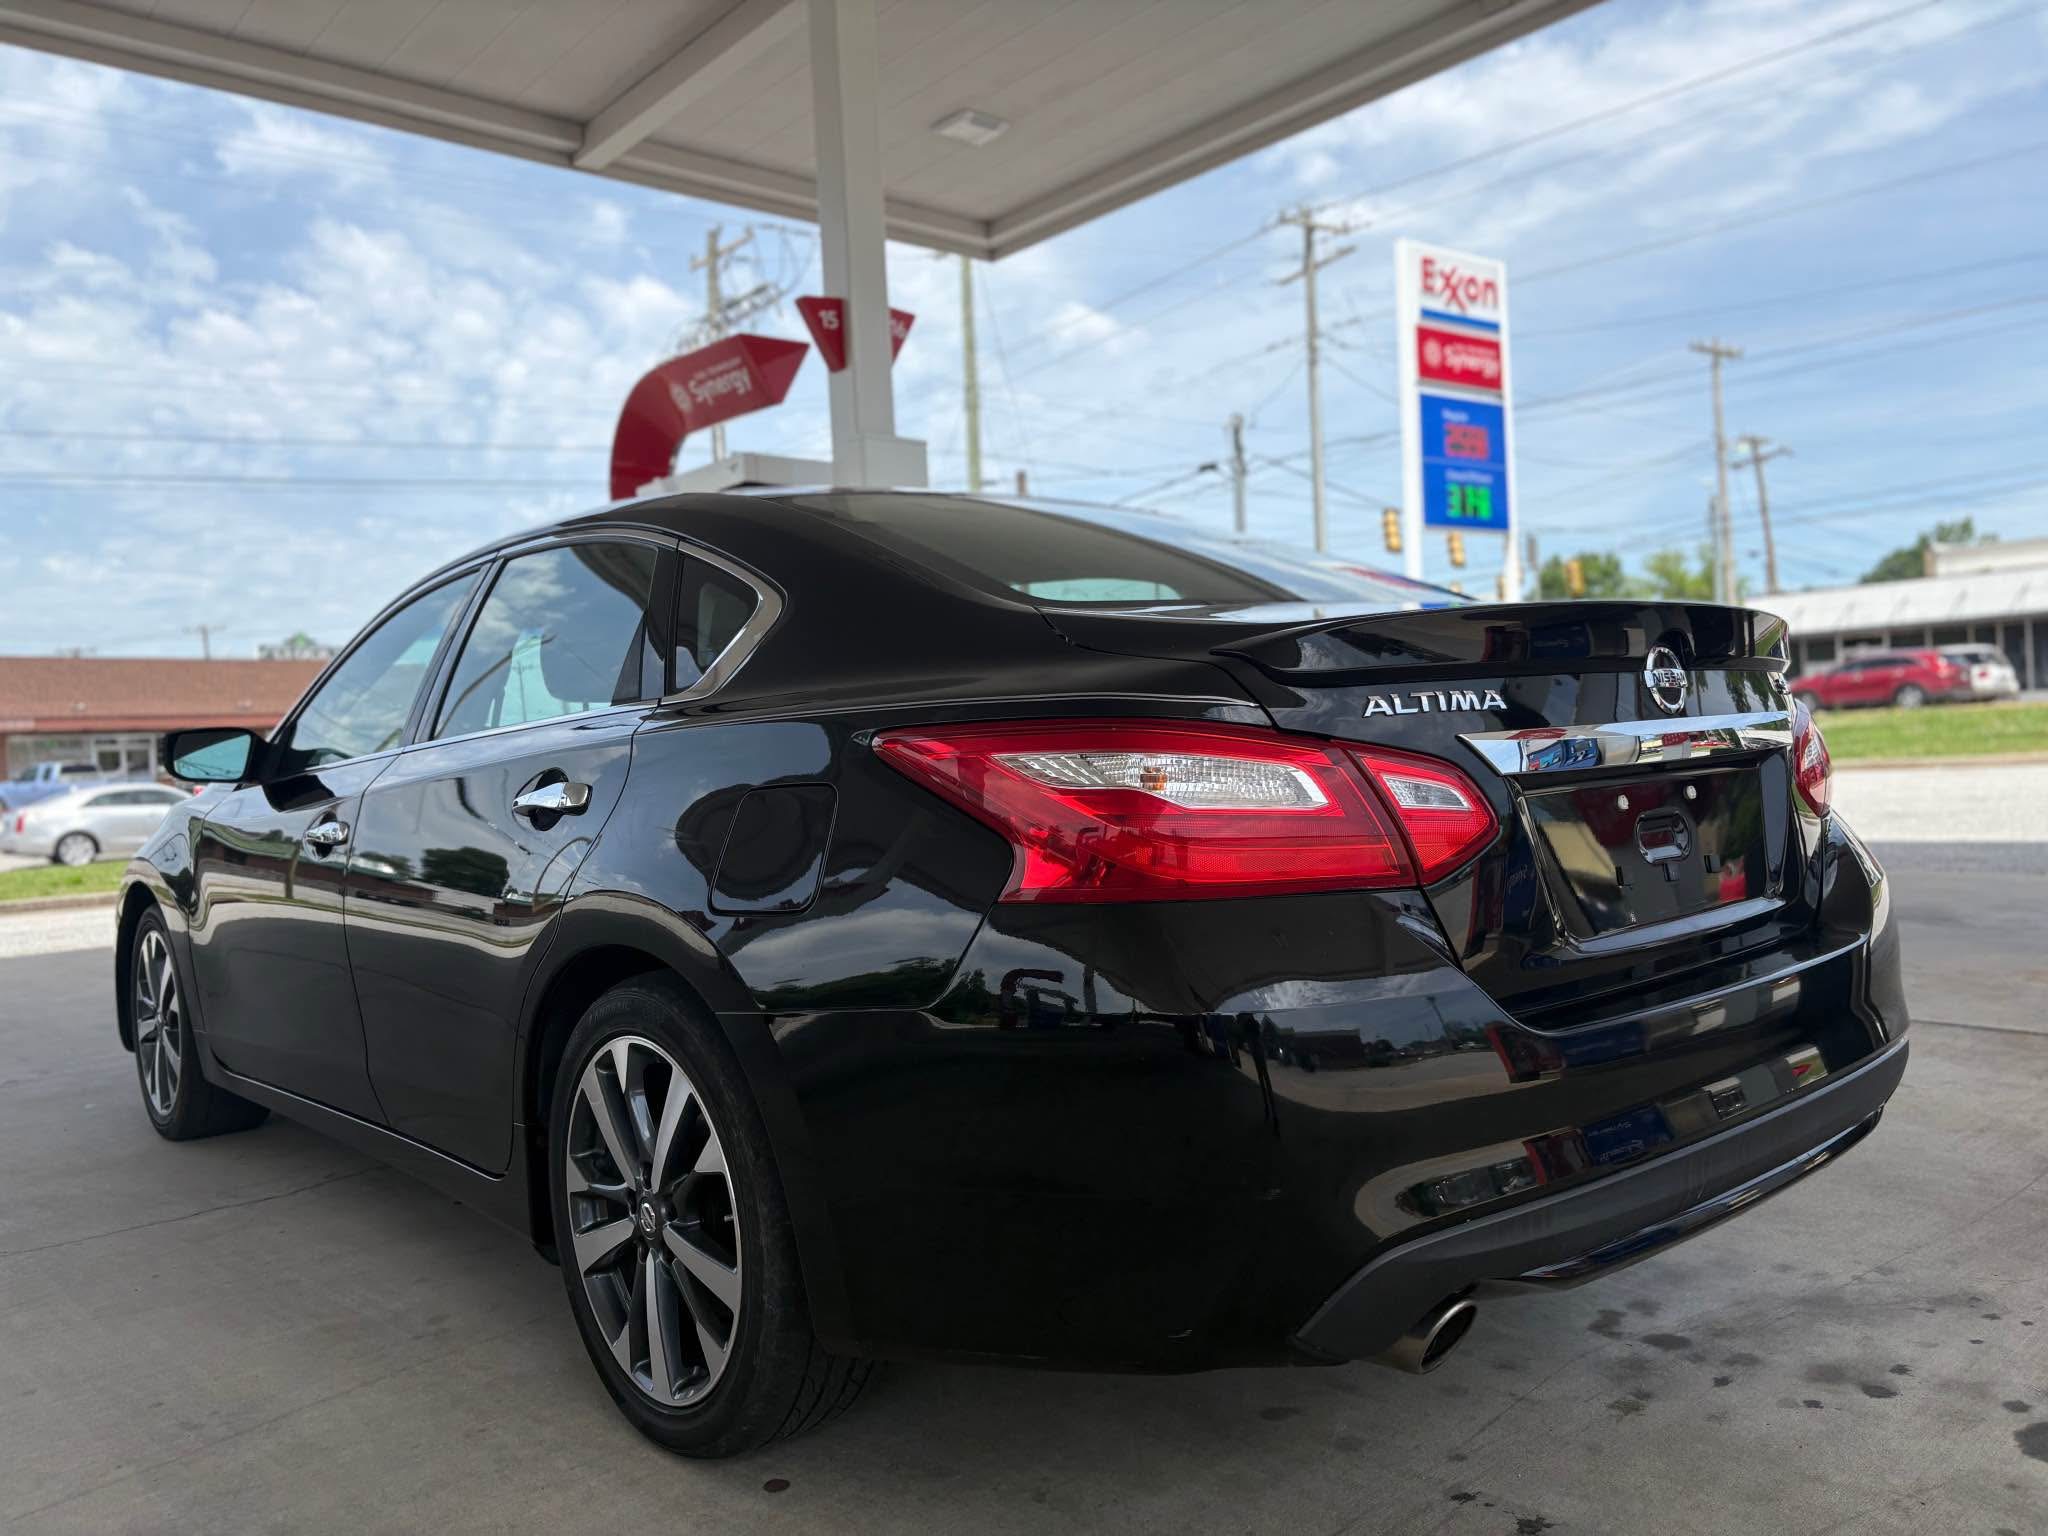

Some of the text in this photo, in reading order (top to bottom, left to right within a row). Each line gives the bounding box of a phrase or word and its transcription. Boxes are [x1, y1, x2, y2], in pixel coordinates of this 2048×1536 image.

[1421, 257, 1498, 314] Exxon
[818, 310, 839, 330] 15
[688, 366, 752, 406] Synergy
[1653, 670, 1686, 684] NISSAN
[1363, 690, 1507, 717] ALTIMA
